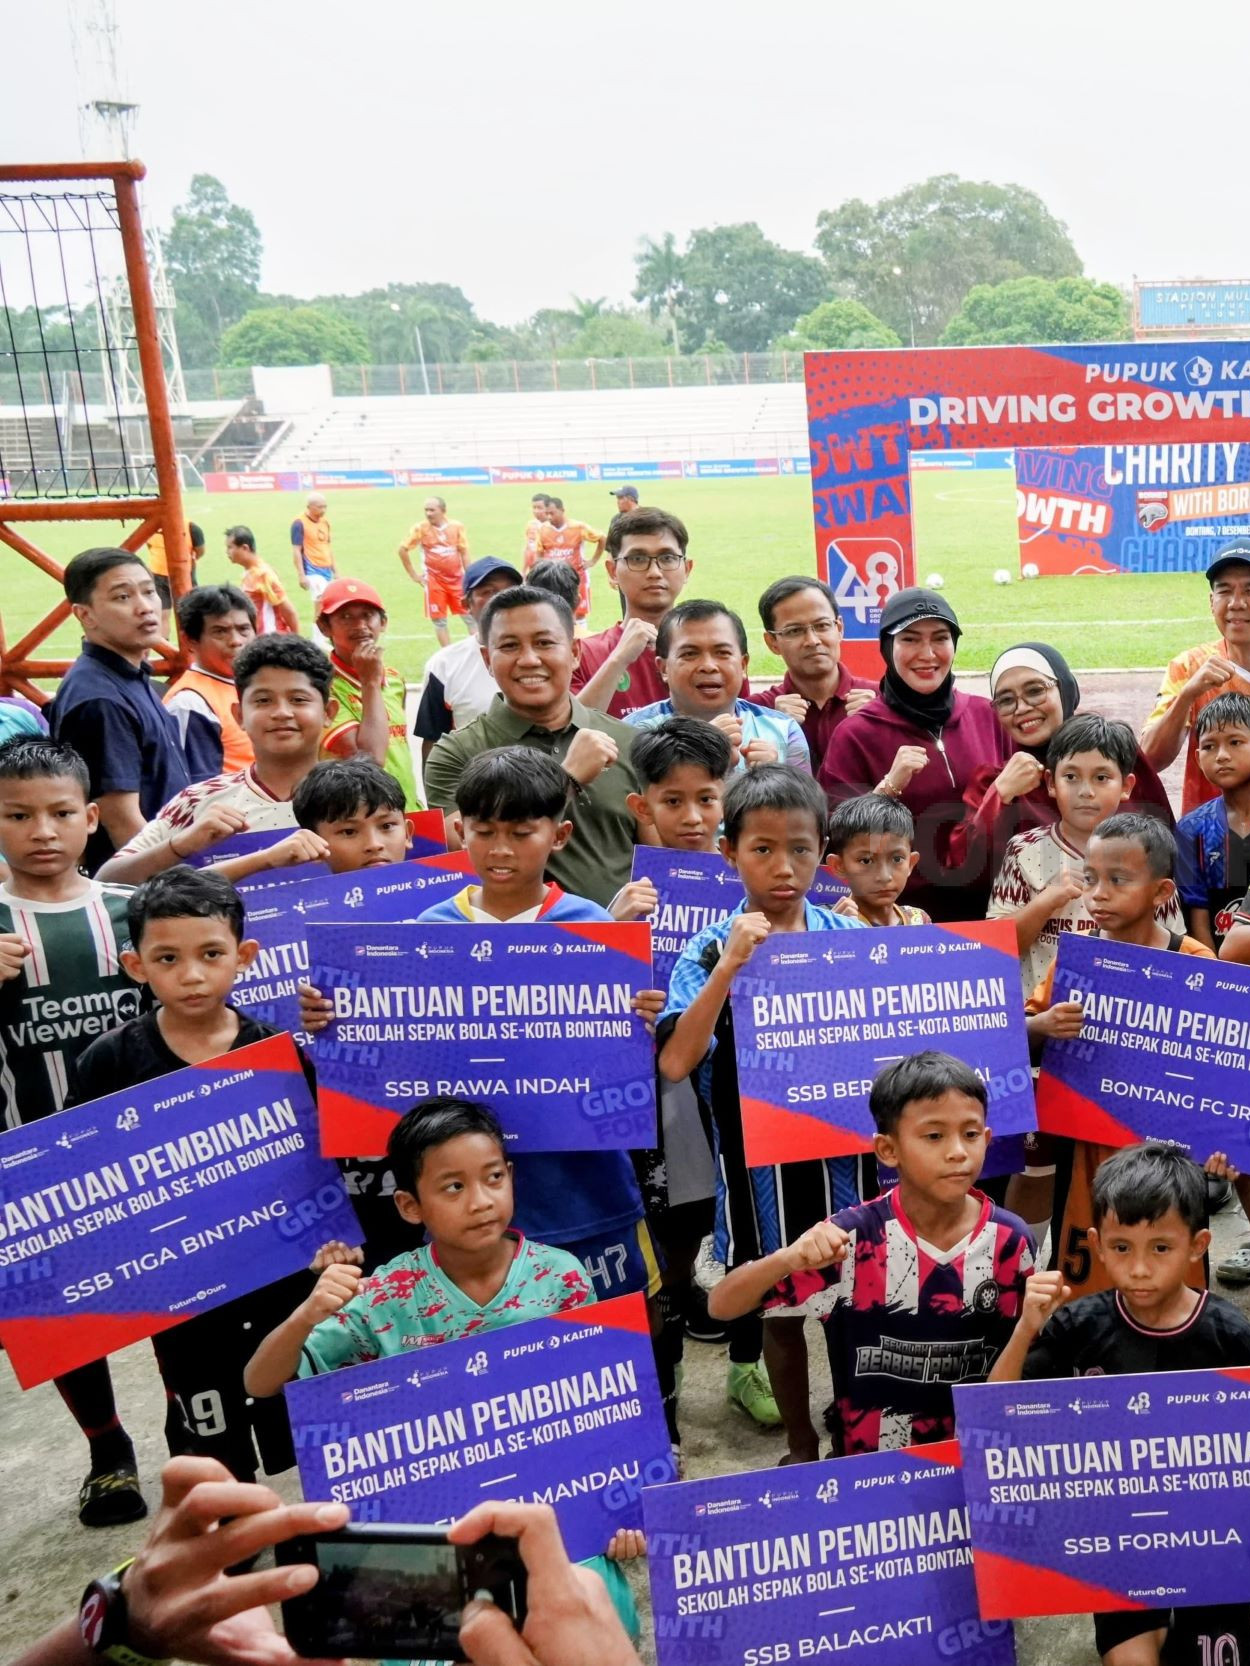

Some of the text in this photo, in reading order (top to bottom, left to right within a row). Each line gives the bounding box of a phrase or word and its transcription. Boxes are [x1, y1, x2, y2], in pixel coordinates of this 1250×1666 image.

[1086, 362, 1177, 383] PUPUK
[909, 394, 1076, 426] DRIVING
[1103, 443, 1241, 485] CHARITY
[1173, 491, 1213, 517] WITH
[469, 939, 492, 961] 48
[507, 944, 605, 953] PUPUK KALTIM
[22, 992, 112, 1022] Team
[333, 984, 631, 1018] BANTUAN PEMBINAAN
[752, 978, 1006, 1026] BANTUAN PEMBINAAN
[8, 1013, 114, 1047] Viewer
[336, 1021, 631, 1041] SEKOLAH SEPAK BOLA SE-KOTA BONTANG
[152, 1069, 254, 1112] PUPUK KALTIM
[385, 1077, 590, 1098] SSB RAWA INDAH
[787, 1085, 827, 1103] SSB
[1101, 1078, 1194, 1111] BONTANG
[1200, 1099, 1224, 1113] FC
[127, 1097, 298, 1186] PEMBINAAN
[62, 1199, 288, 1304] SSB TIGA BINTANG
[584, 1243, 627, 1289] 47
[1064, 1226, 1091, 1283] 5
[502, 1325, 603, 1359] PUPUK KALTIM
[1125, 1391, 1151, 1414] 48
[1166, 1393, 1210, 1404] PUPUK
[322, 1360, 638, 1479] BANTUAN PEMBINAAN
[330, 1398, 642, 1505] SEKOLAH SEPAK BOLA SE-KOTA BONTANG
[984, 1440, 1122, 1479] BANTUAN
[534, 1460, 640, 1503] MANDAU
[989, 1482, 1061, 1503] SEKOLAH
[1063, 1478, 1115, 1498] SEPAK
[1118, 1475, 1158, 1494] BOLA
[1161, 1471, 1228, 1491] SE-KOTA
[1064, 1528, 1241, 1554] SSB FORMULA
[673, 1533, 810, 1589] BANTUAN
[744, 1616, 932, 1666] SSB BALACAKTI
[1197, 1633, 1240, 1666] 10
